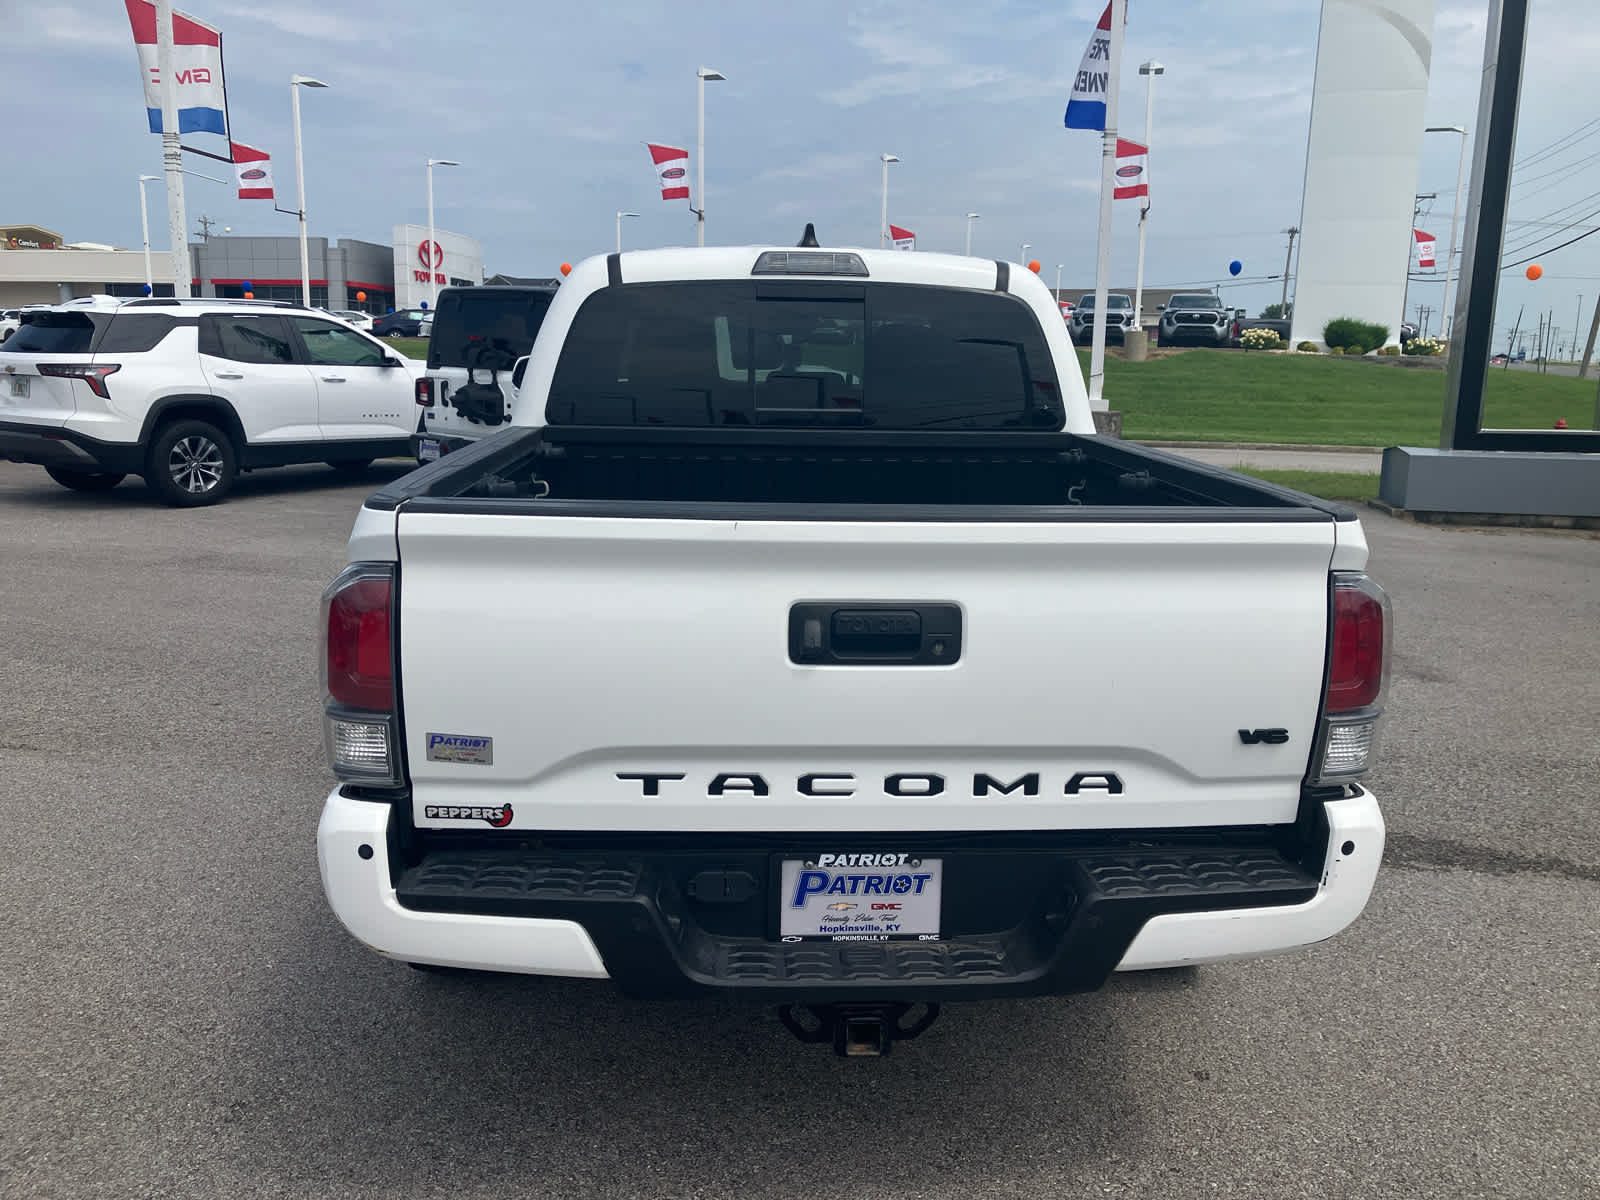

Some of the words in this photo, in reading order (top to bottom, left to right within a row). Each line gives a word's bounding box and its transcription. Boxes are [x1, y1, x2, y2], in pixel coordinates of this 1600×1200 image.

[413, 270, 447, 285] TOYTA
[429, 735, 489, 749] PATRIOT
[1238, 727, 1289, 744] V6
[616, 772, 1123, 796] TACOMA
[426, 807, 505, 819] PEPPERS
[818, 853, 910, 867] PATRIOT
[791, 870, 934, 909] PATRIOT
[819, 924, 883, 933] Hopkinsville,
[885, 924, 901, 932] KY
